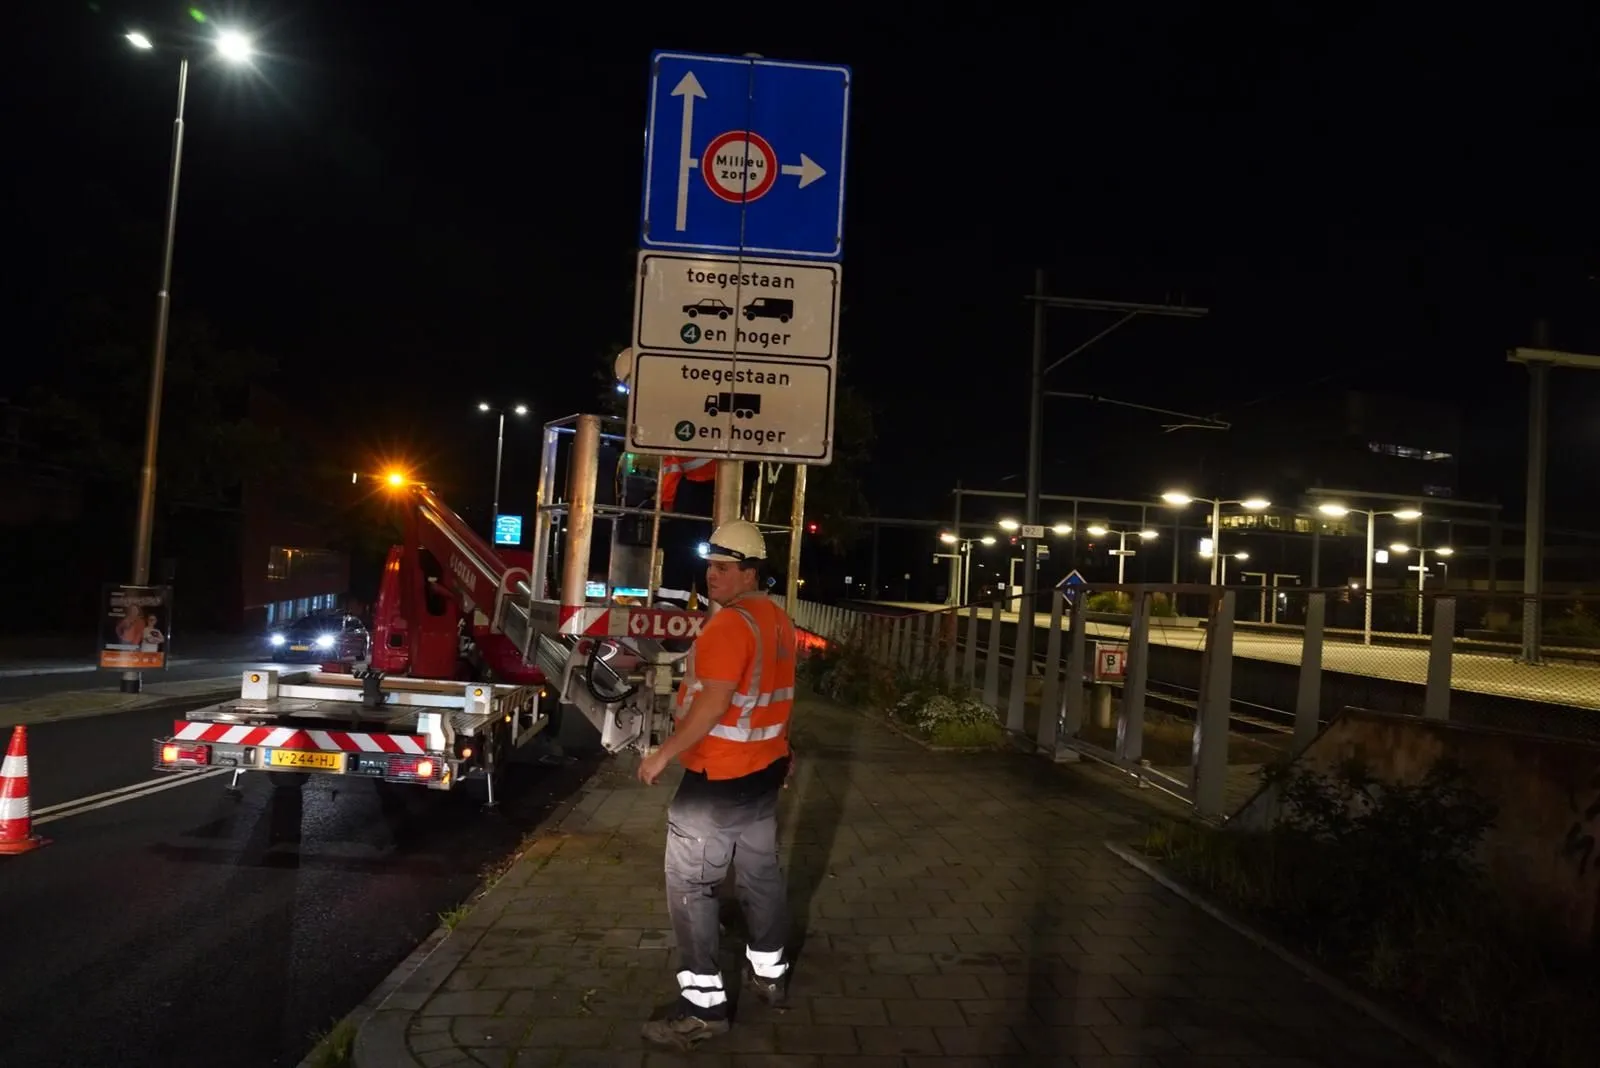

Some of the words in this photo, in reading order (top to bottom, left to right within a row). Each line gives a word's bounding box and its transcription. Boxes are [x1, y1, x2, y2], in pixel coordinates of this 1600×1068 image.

[716, 155, 764, 168] Milieu
[686, 267, 795, 289] toegestaan
[704, 328, 727, 342] en
[736, 327, 791, 349] hoger
[681, 364, 790, 386] toegestaan
[698, 425, 722, 439] en
[730, 424, 786, 446] hoger
[653, 614, 706, 637] LOX
[1106, 654, 1116, 666] B
